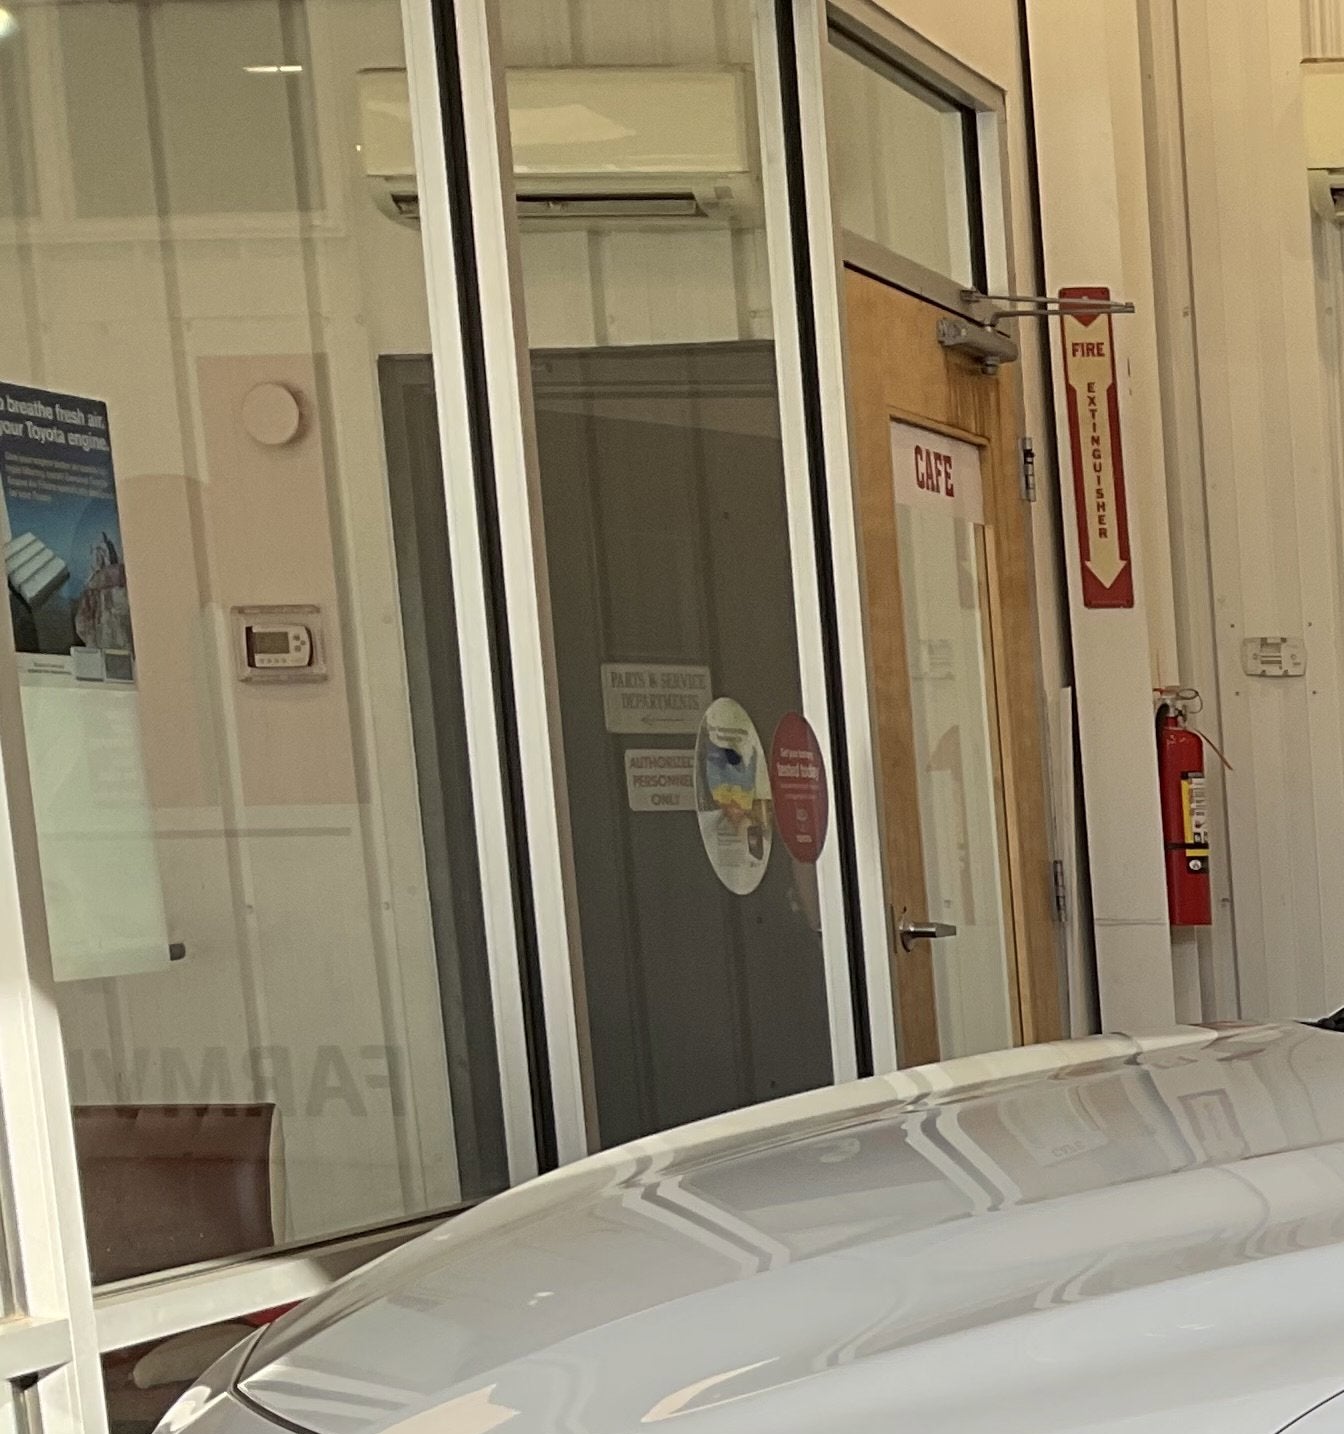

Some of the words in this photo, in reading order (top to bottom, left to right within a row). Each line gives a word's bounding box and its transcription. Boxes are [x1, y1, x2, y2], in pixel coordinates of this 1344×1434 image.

[1071, 341, 1106, 358] FIRE
[5, 394, 53, 420] breathe
[55, 403, 85, 425] fresh
[25, 420, 66, 444] Toyota
[1086, 381, 1108, 539] EXTINGUISHER
[914, 444, 955, 498] CAFE
[610, 671, 646, 689] PARTS
[660, 672, 706, 690] SERVICE
[629, 756, 694, 769] AUTHORIZED
[632, 774, 694, 787] PERSONNEL
[651, 793, 680, 806] ONLY
